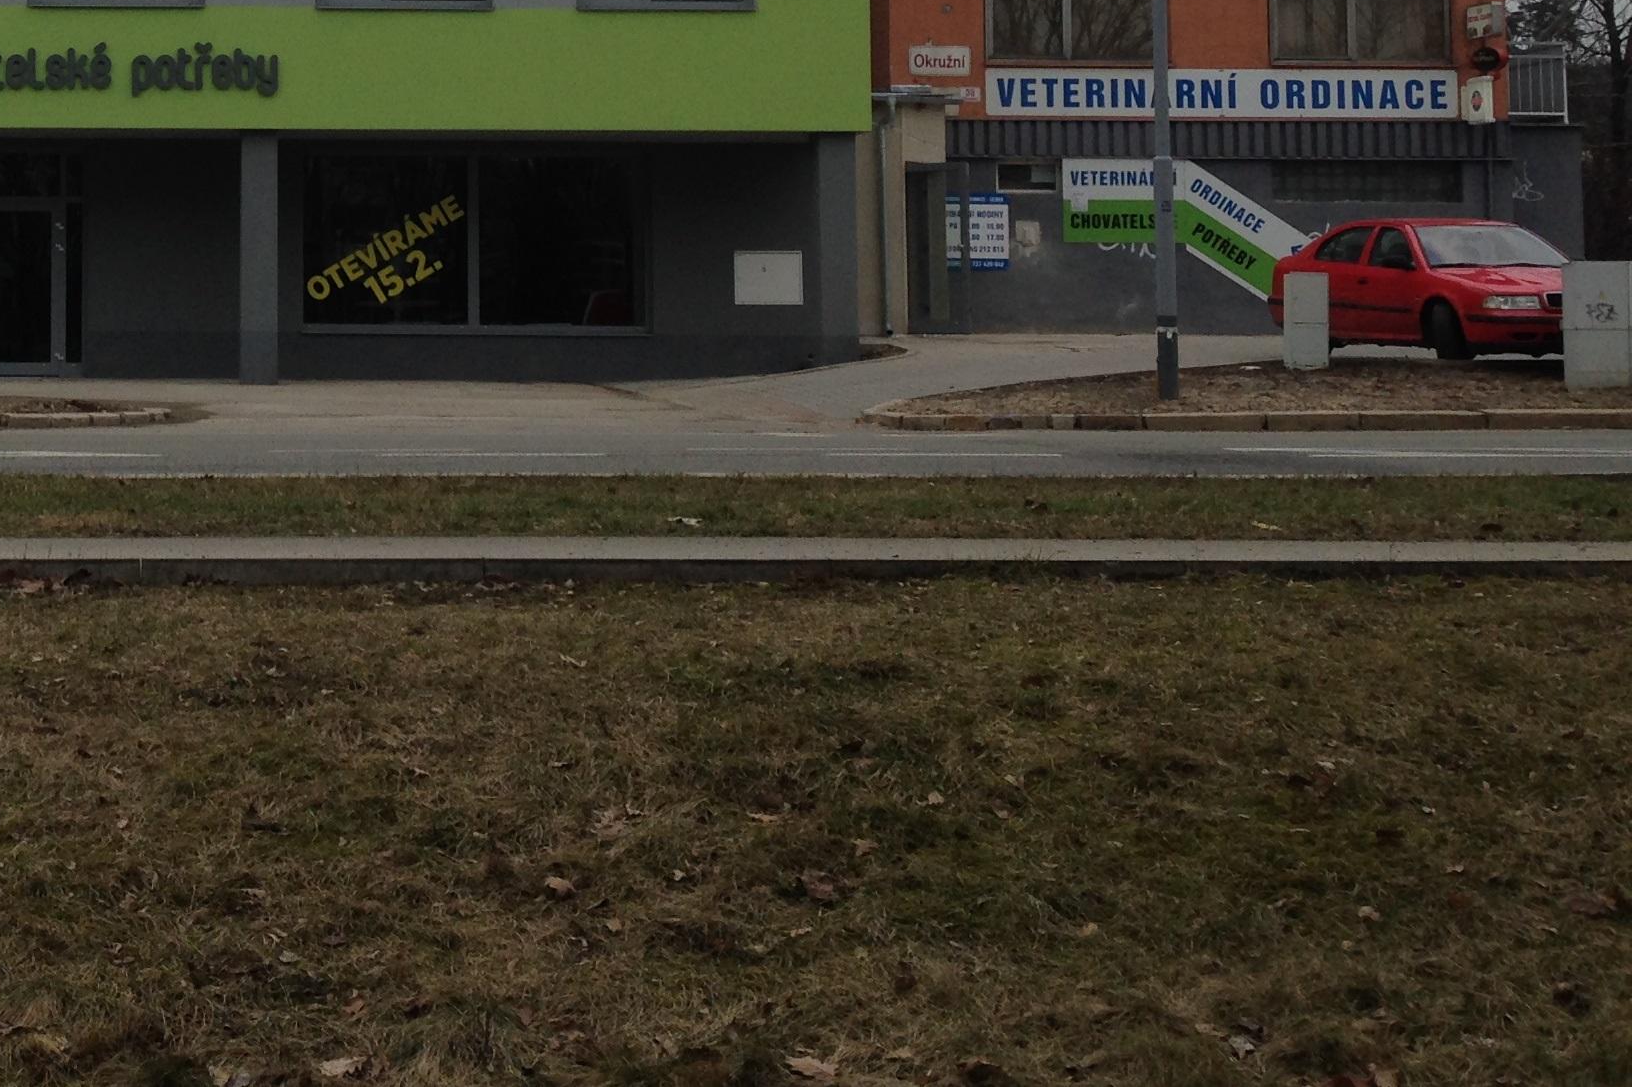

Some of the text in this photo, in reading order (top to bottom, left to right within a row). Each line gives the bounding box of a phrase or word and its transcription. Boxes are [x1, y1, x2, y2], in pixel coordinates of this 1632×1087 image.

[130, 42, 279, 98] potřeby
[914, 54, 966, 68] Okružní
[996, 74, 1449, 110] VETERINRNÍ ORDINACE
[1070, 169, 1265, 233] VETERINÁÍ ORDINACE
[306, 194, 465, 301] OTEVÍRÁME
[1070, 213, 1177, 229] CHOVATELS
[1192, 223, 1256, 270] POTŘEBY
[363, 250, 444, 304] 15.2.
